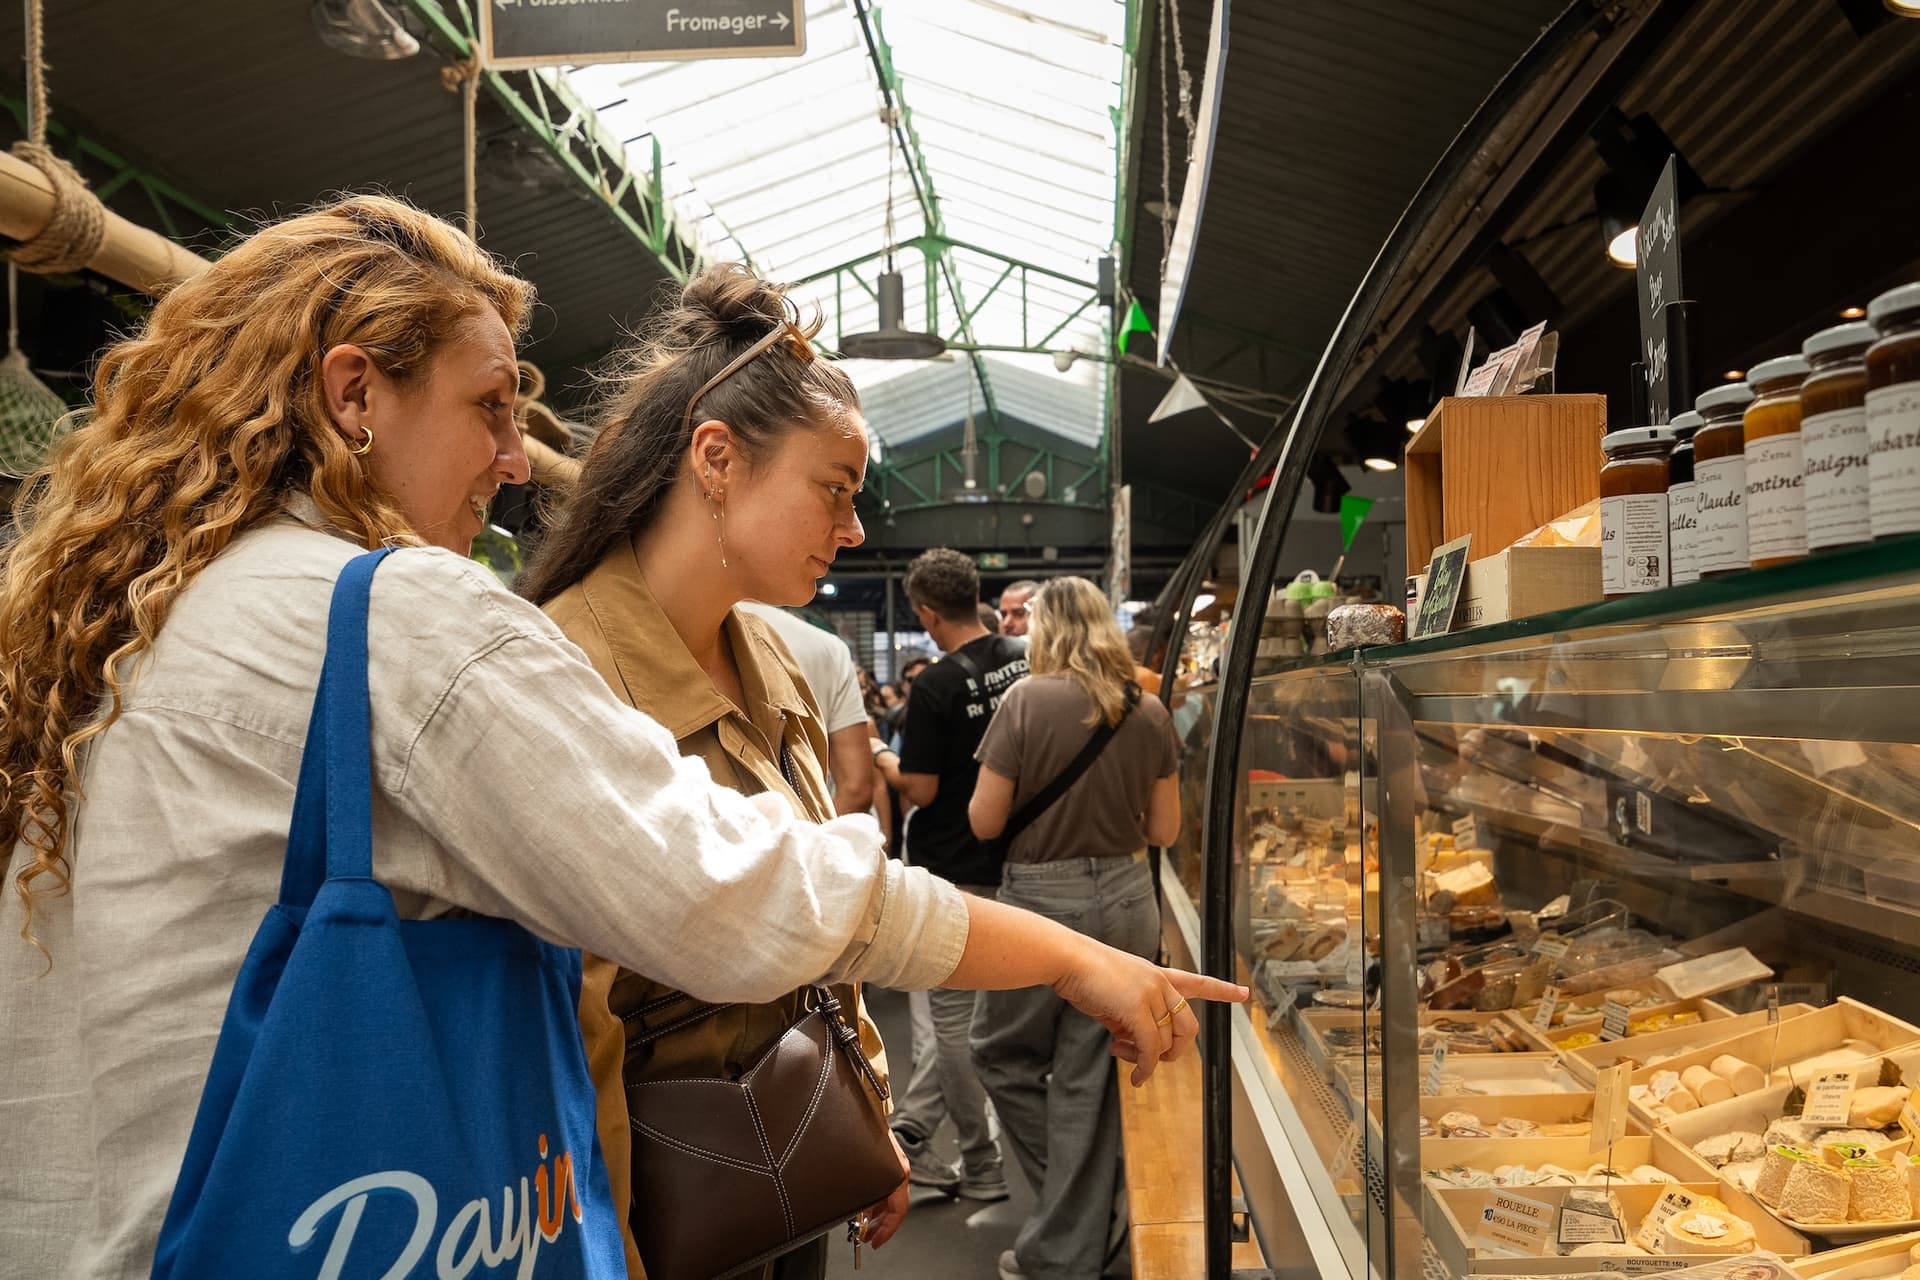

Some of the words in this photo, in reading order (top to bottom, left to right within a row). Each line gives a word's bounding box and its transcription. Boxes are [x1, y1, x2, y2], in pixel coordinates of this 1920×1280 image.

[667, 8, 767, 35] Fromager
[1697, 490, 1742, 514] Claude
[1496, 1197, 1540, 1218] ROUELLE
[1506, 1218, 1515, 1229] LA
